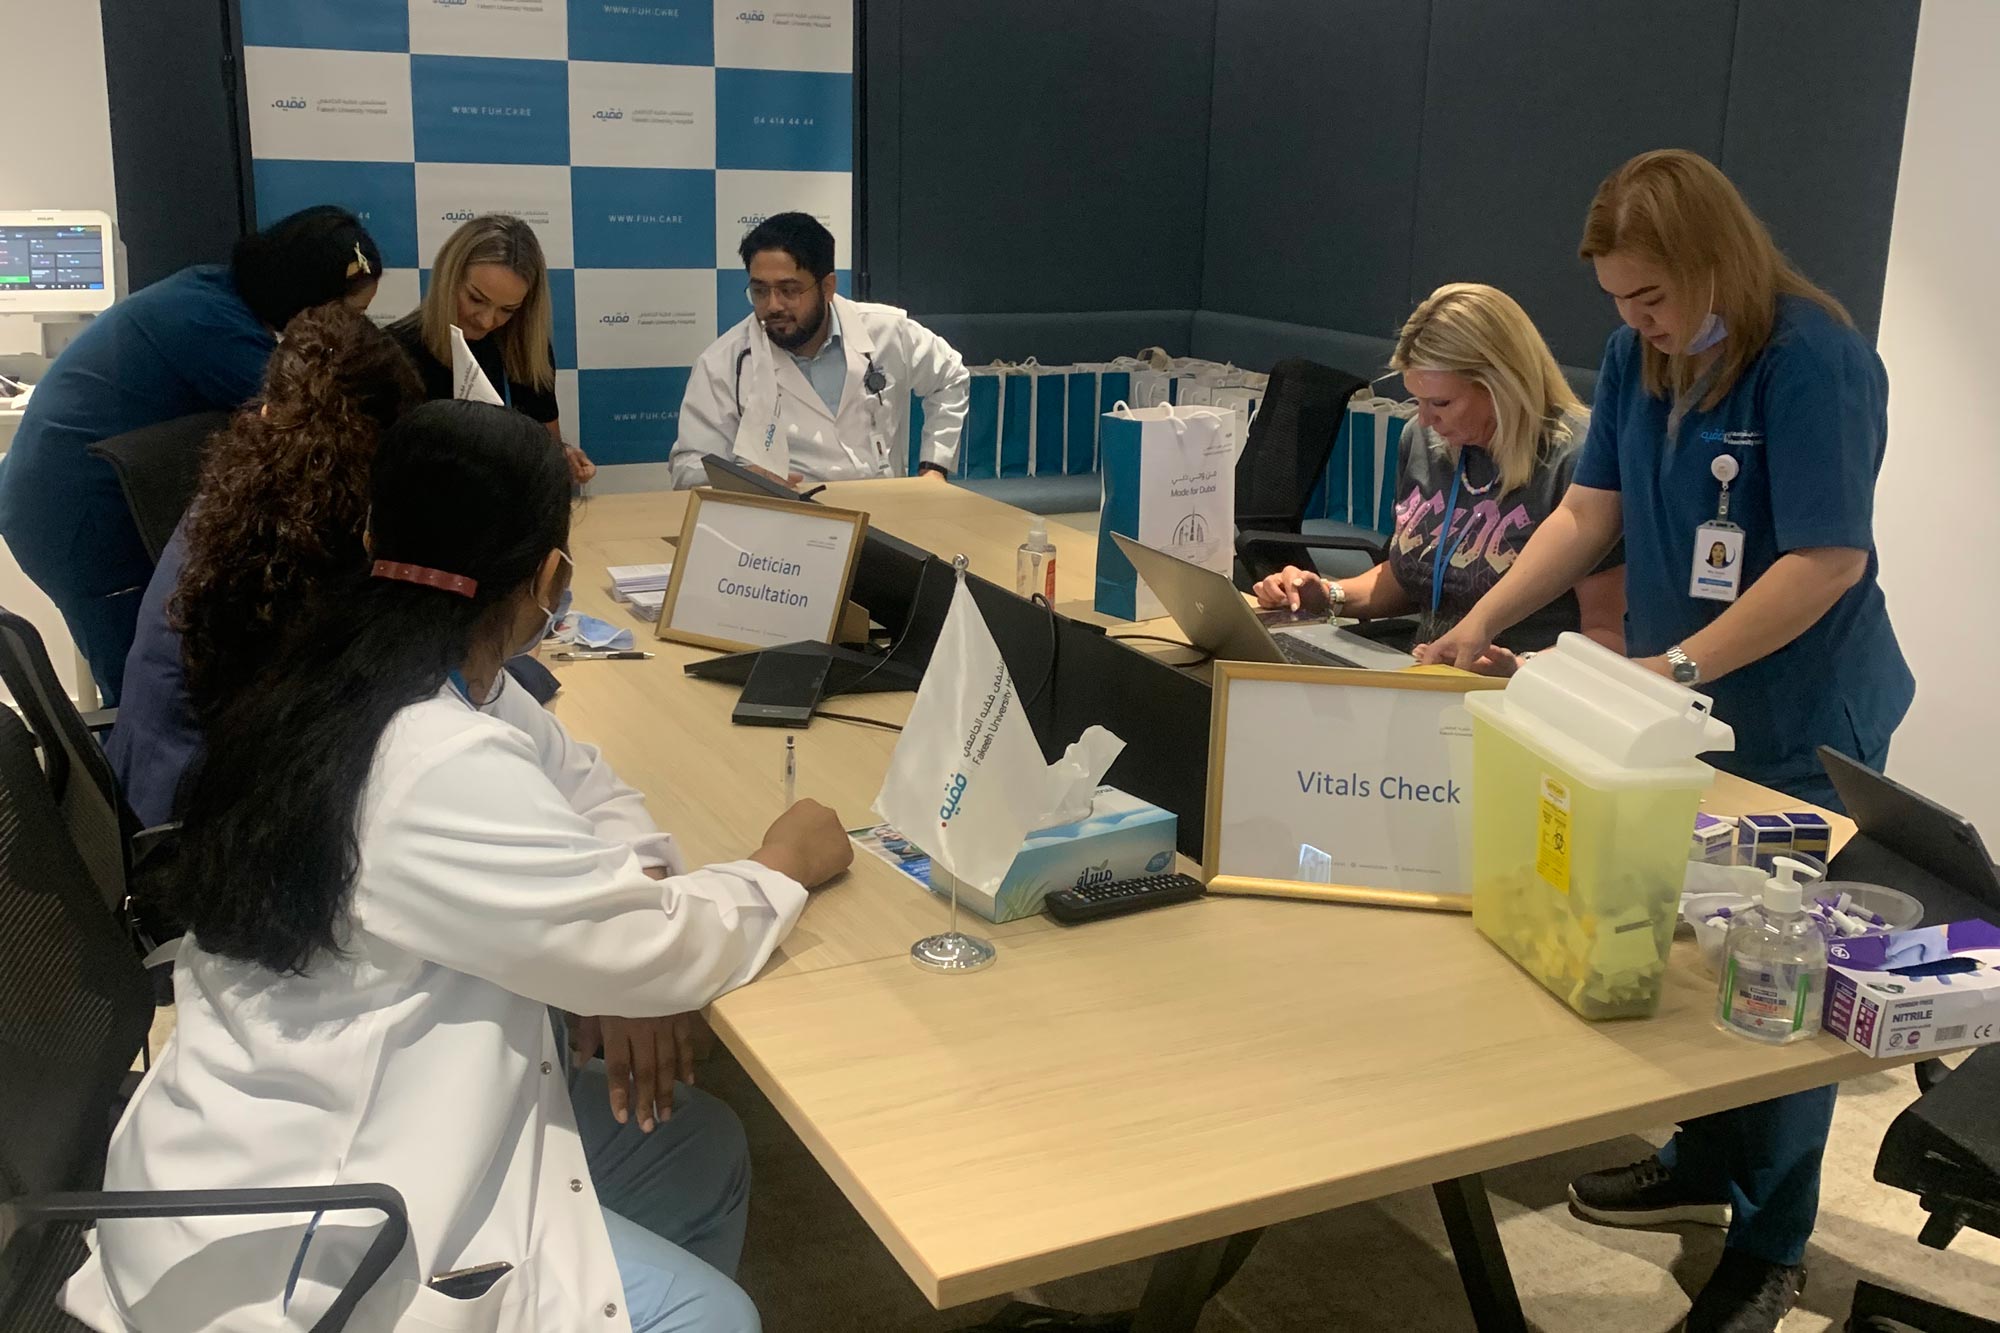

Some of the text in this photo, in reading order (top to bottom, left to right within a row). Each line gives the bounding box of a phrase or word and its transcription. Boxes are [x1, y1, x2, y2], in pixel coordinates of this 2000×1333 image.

[608, 214, 683, 224] WWW.FUH.CARE
[1190, 487, 1198, 495] for
[1200, 485, 1216, 494] Dubai
[738, 552, 801, 576] Dietician
[717, 578, 809, 608] Consultation
[972, 689, 1012, 766] Fakeeh University
[1297, 770, 1461, 804] Vitals Check
[1892, 1010, 1933, 1023] NITRILE
